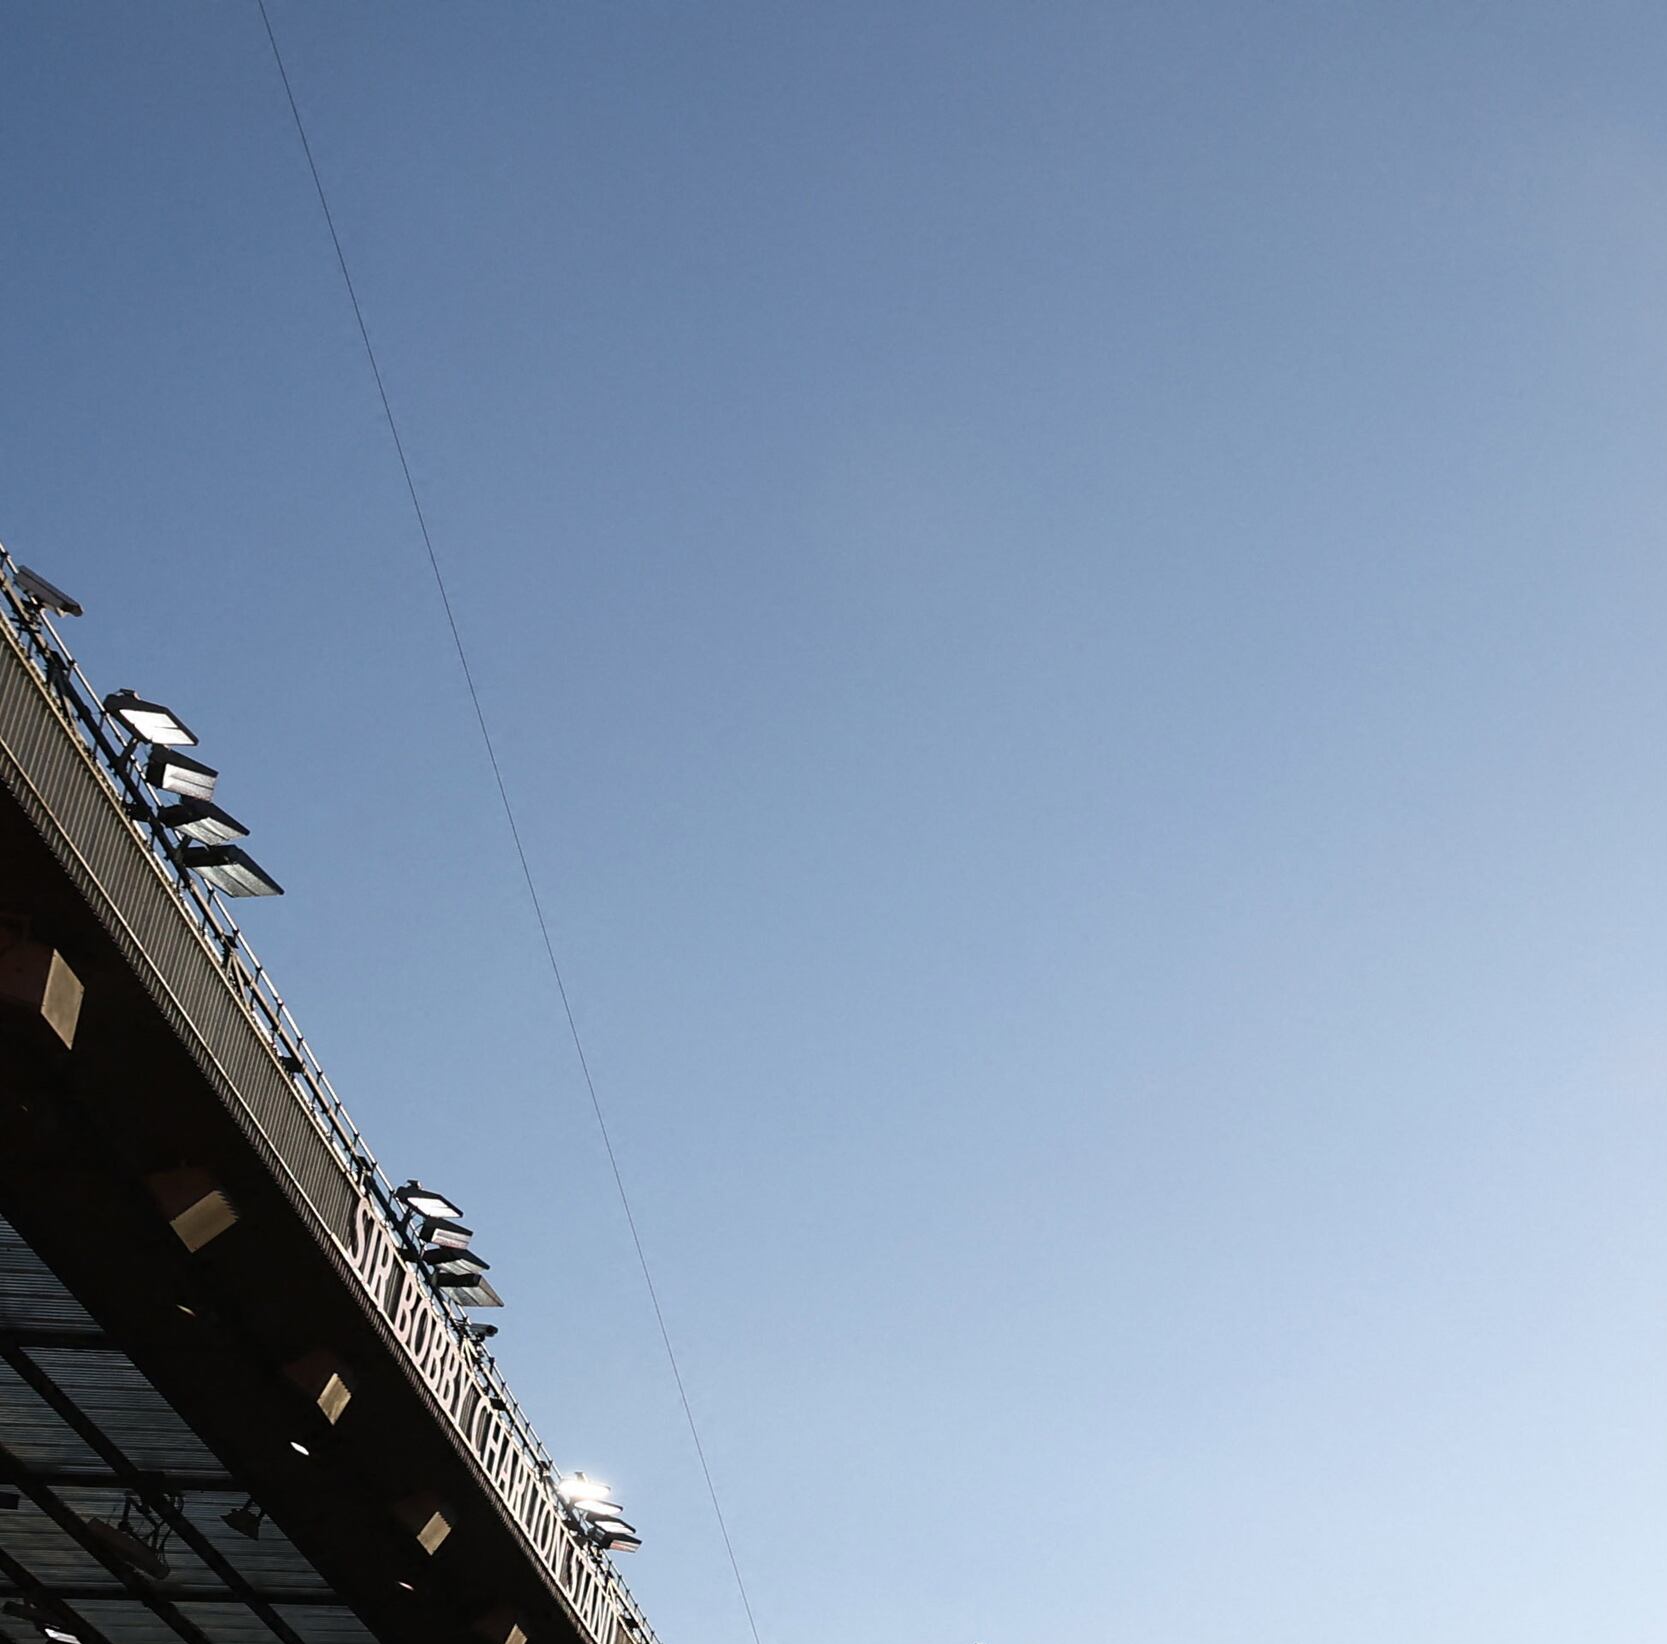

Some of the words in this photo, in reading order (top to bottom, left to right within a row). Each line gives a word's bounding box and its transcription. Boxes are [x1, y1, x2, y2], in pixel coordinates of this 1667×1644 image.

[349, 1198, 394, 1310] SIR
[394, 1271, 475, 1425] BOBBY
[471, 1397, 568, 1582] CHARLTON
